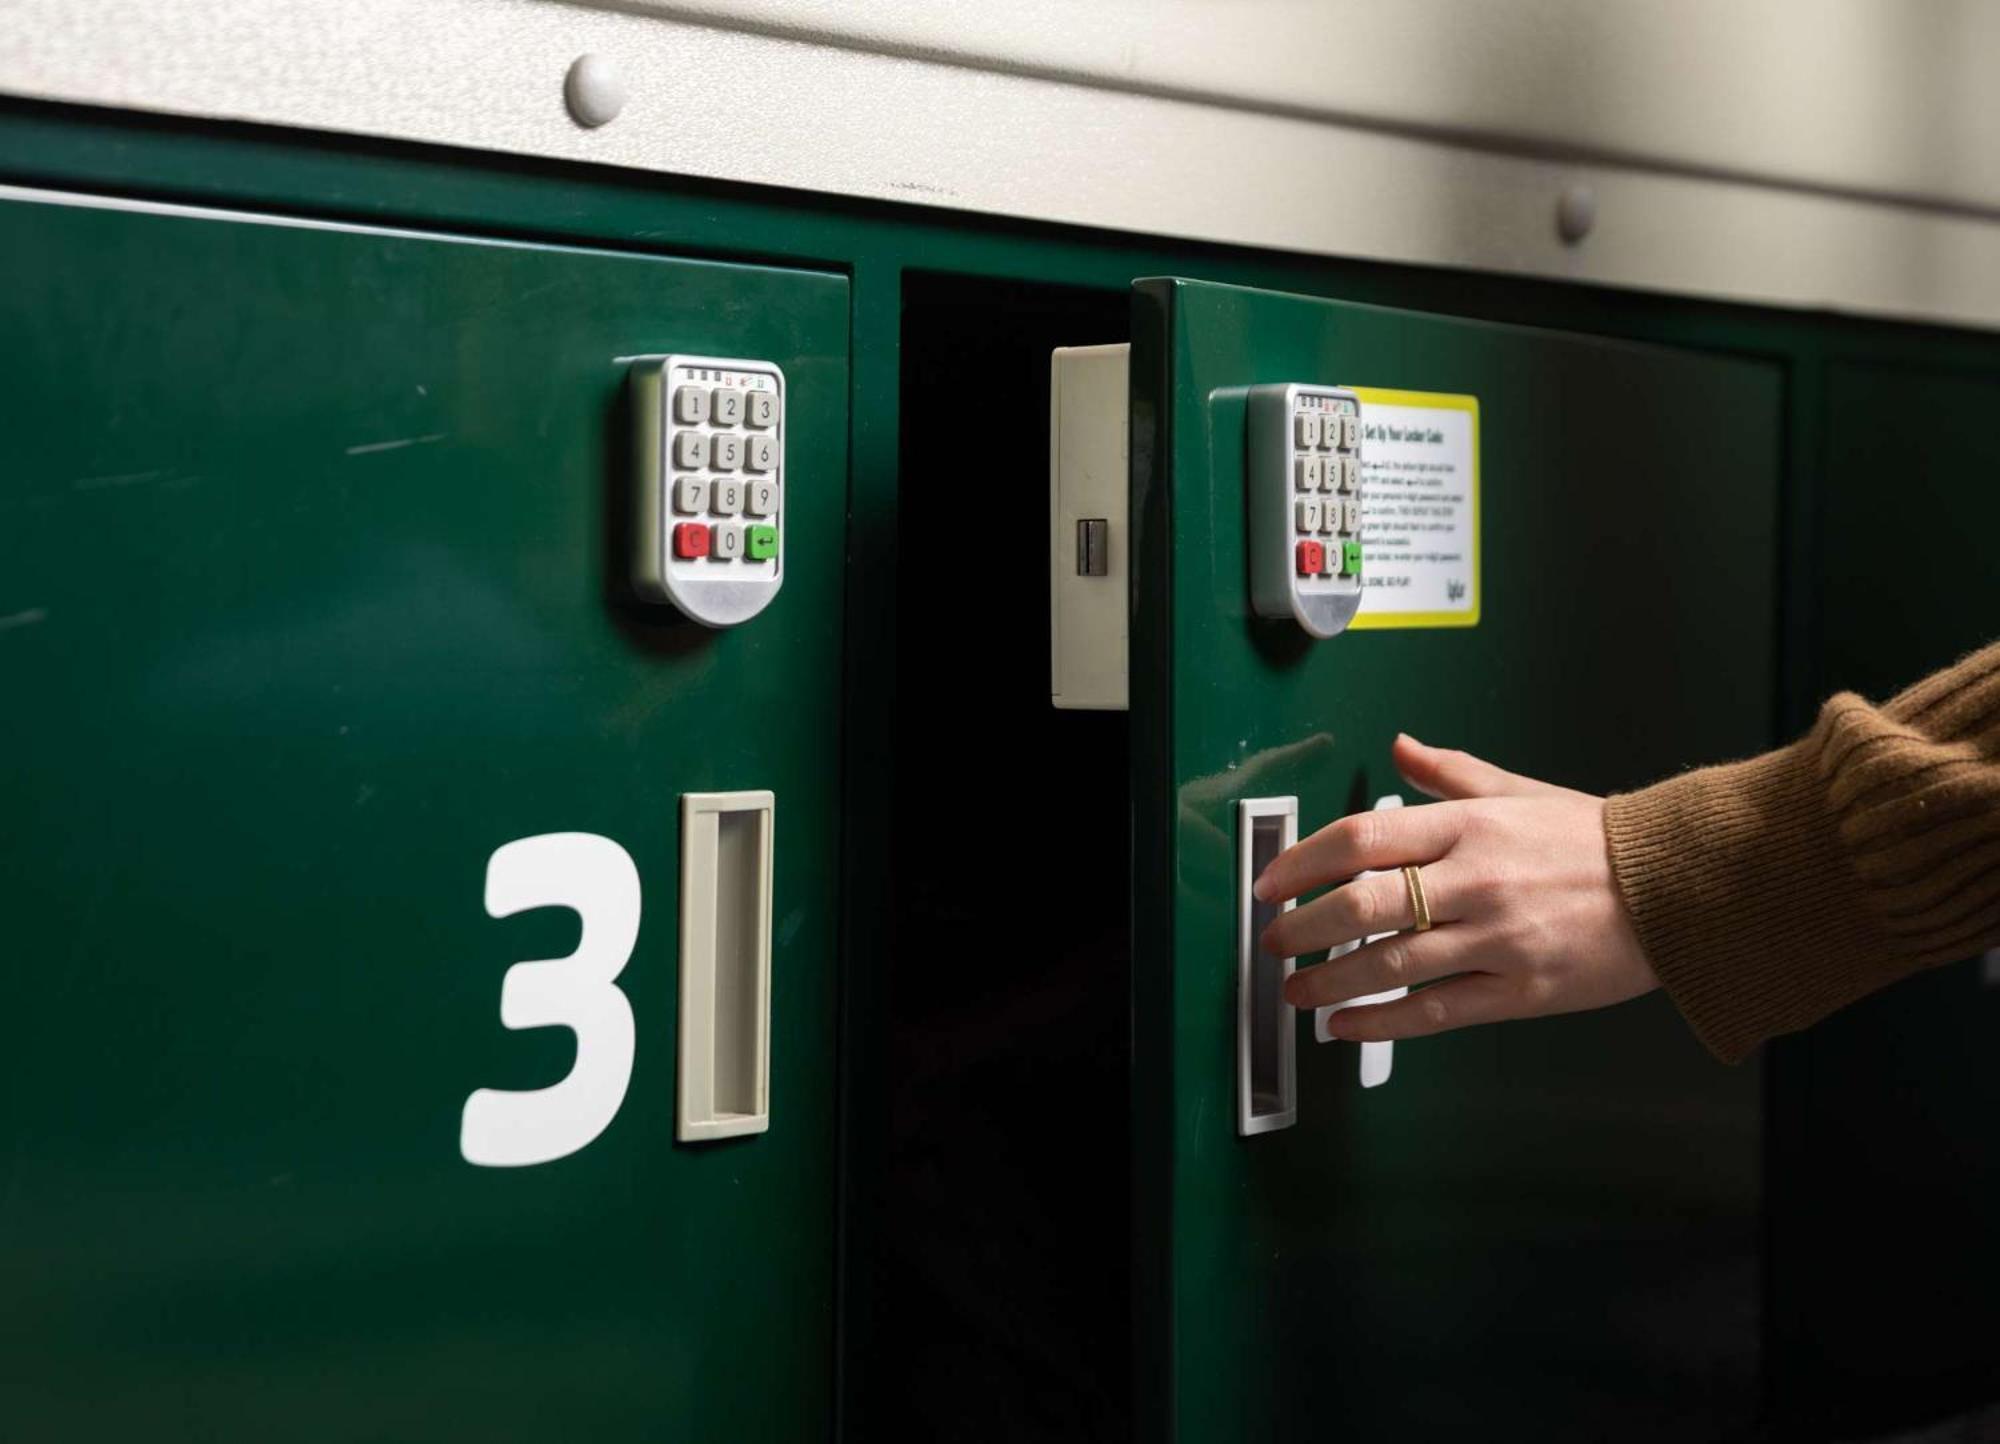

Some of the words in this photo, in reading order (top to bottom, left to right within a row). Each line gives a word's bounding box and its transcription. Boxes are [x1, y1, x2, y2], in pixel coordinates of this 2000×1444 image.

[692, 397, 699, 415] 1
[726, 398, 736, 416] 2
[761, 400, 770, 419] 3
[1309, 422, 1313, 439] 1
[1329, 423, 1336, 440] 2
[1350, 424, 1356, 442] 3
[690, 443, 700, 460] 4
[726, 444, 735, 461] 5
[761, 444, 769, 463] 6
[1308, 465, 1315, 481] 4
[1328, 465, 1336, 482] 5
[1350, 466, 1356, 483] 6
[691, 486, 700, 504] 7
[726, 488, 736, 506] 8
[760, 489, 769, 507] 9
[1310, 506, 1317, 524] 7
[1330, 507, 1337, 525] 8
[1350, 508, 1357, 524] 9
[690, 531, 700, 548] C
[726, 532, 735, 550] 0
[1309, 548, 1316, 566] C
[460, 831, 641, 1166] 3
